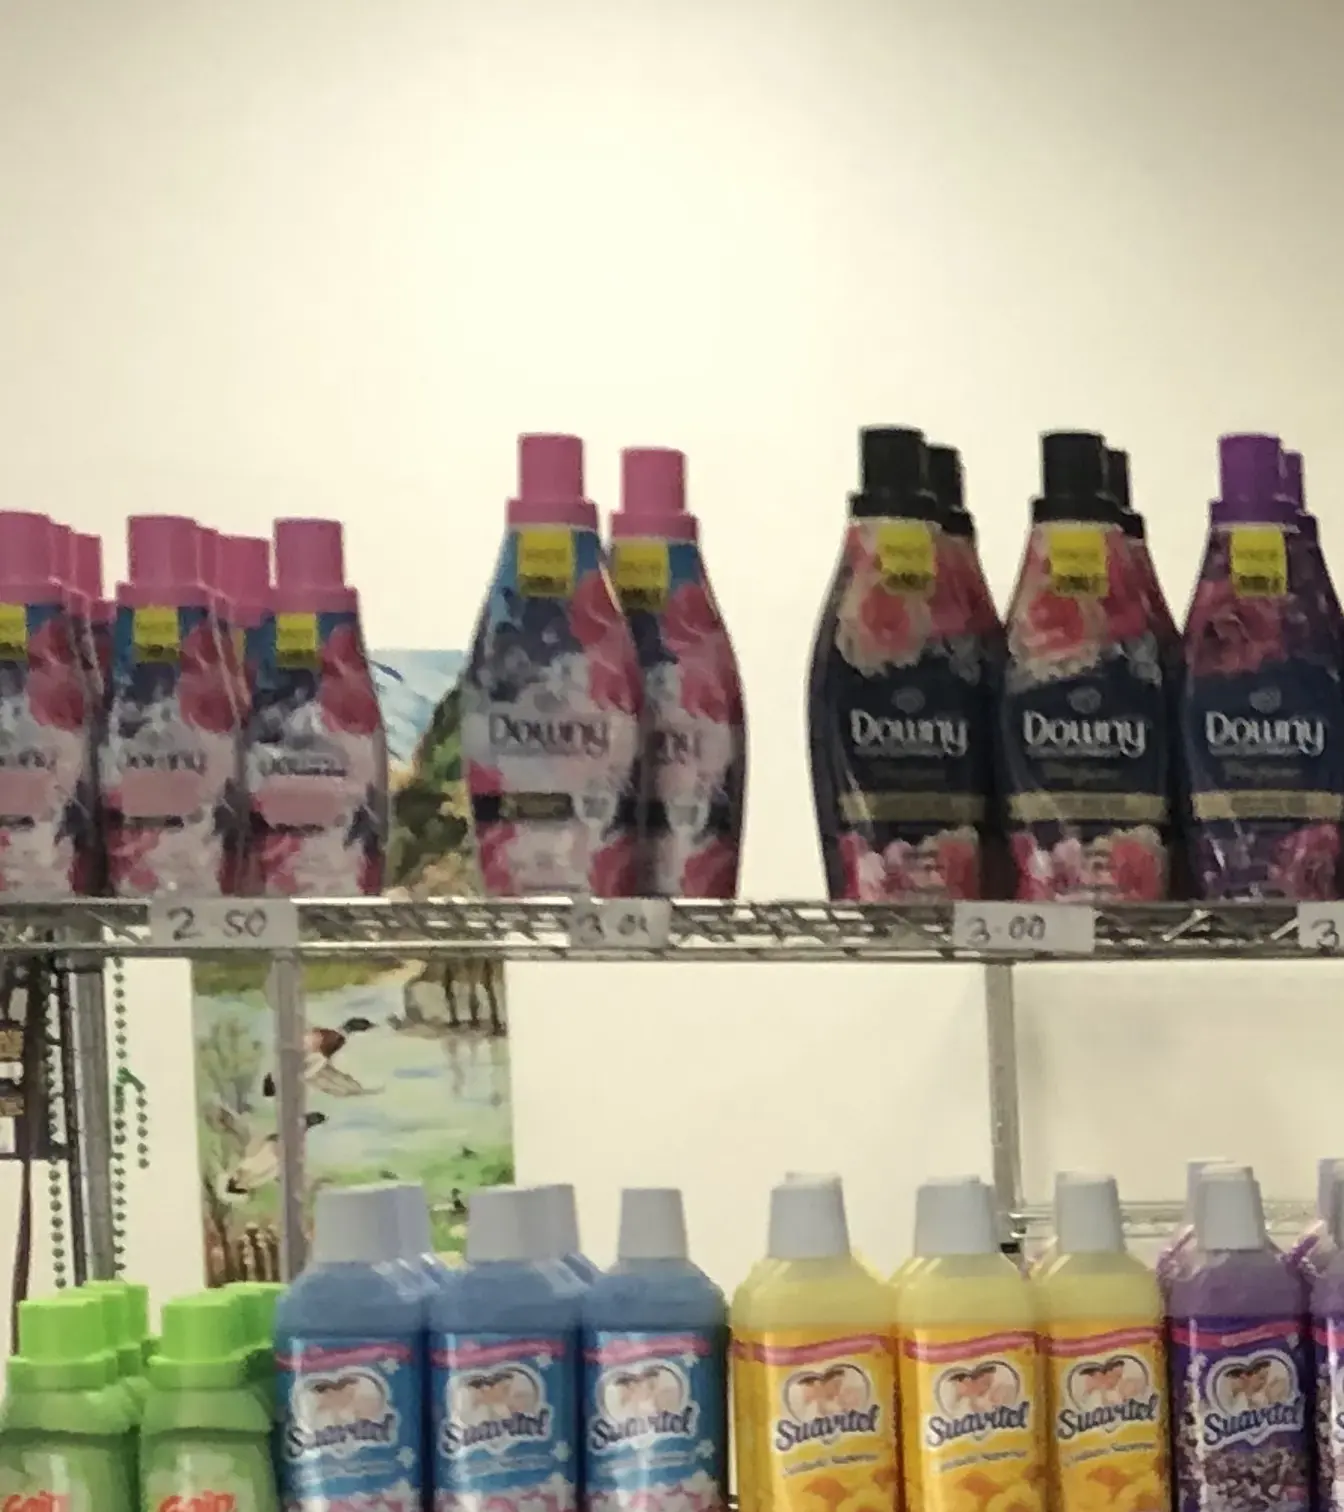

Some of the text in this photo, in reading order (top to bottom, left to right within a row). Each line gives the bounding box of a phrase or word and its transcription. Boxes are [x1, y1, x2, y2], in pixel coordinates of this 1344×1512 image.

[849, 708, 970, 755] Downy
[1022, 709, 1148, 756] Downy
[1204, 708, 1326, 756] Downy
